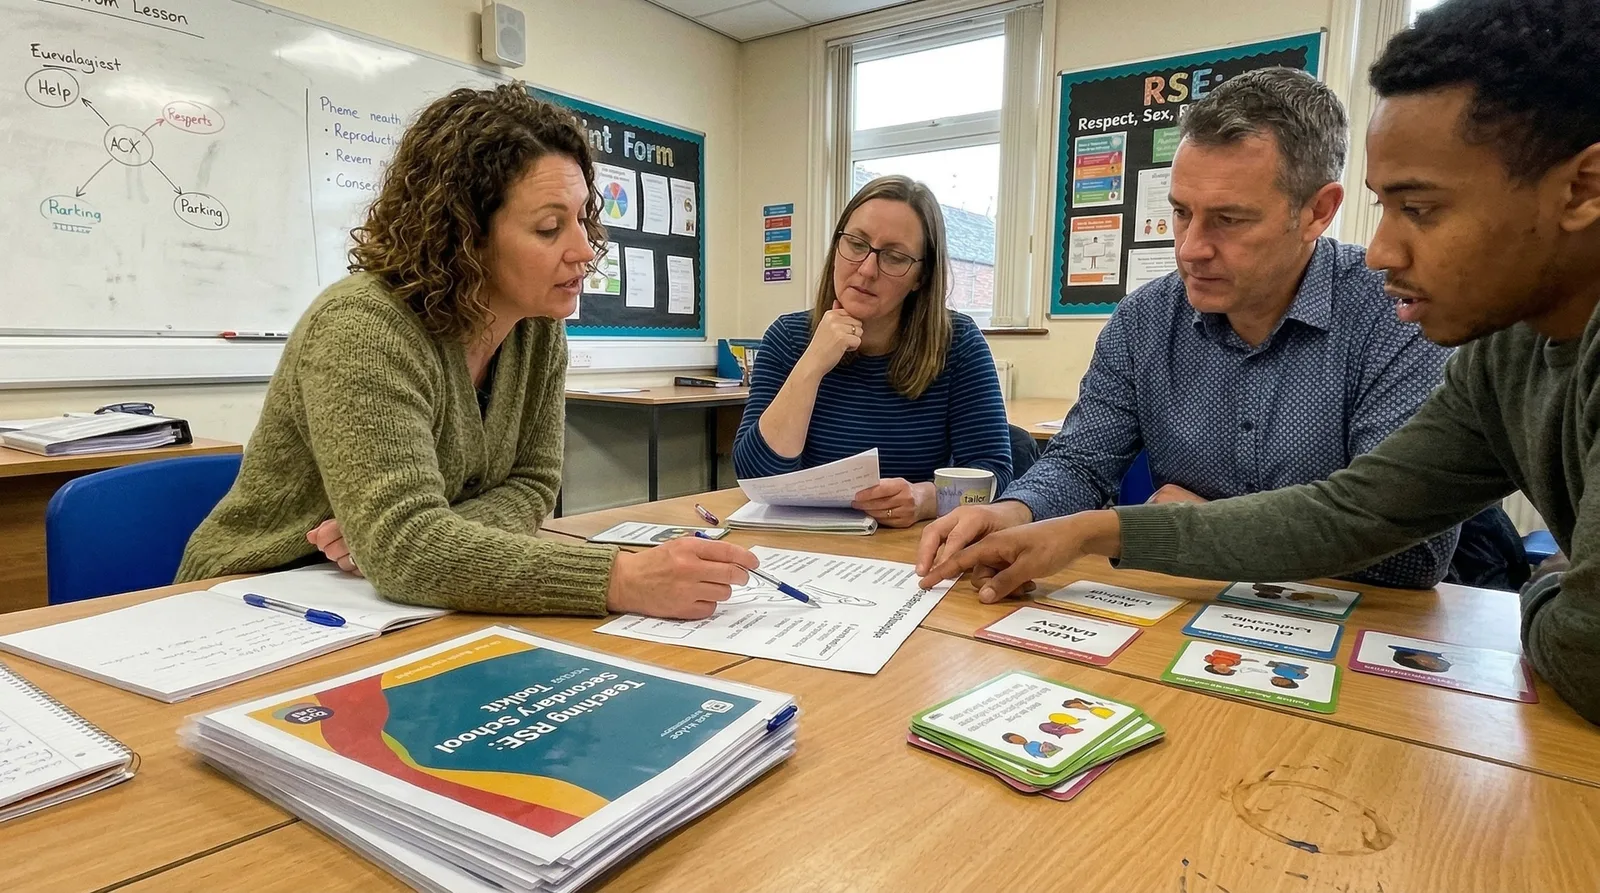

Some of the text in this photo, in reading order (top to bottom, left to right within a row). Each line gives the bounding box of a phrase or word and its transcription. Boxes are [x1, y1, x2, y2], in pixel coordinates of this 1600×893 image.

[133, 0, 188, 25] Lesson
[38, 79, 71, 102] Help
[1078, 112, 1138, 131] Respect,
[1142, 108, 1174, 122] Sex,
[110, 136, 140, 154] ACX
[624, 130, 675, 168] Form
[49, 199, 101, 223] Rarking
[181, 198, 223, 226] Parking
[480, 683, 554, 713] Toolkit
[434, 671, 619, 754] Secondary School
[487, 679, 646, 751] Teaching RSE:
